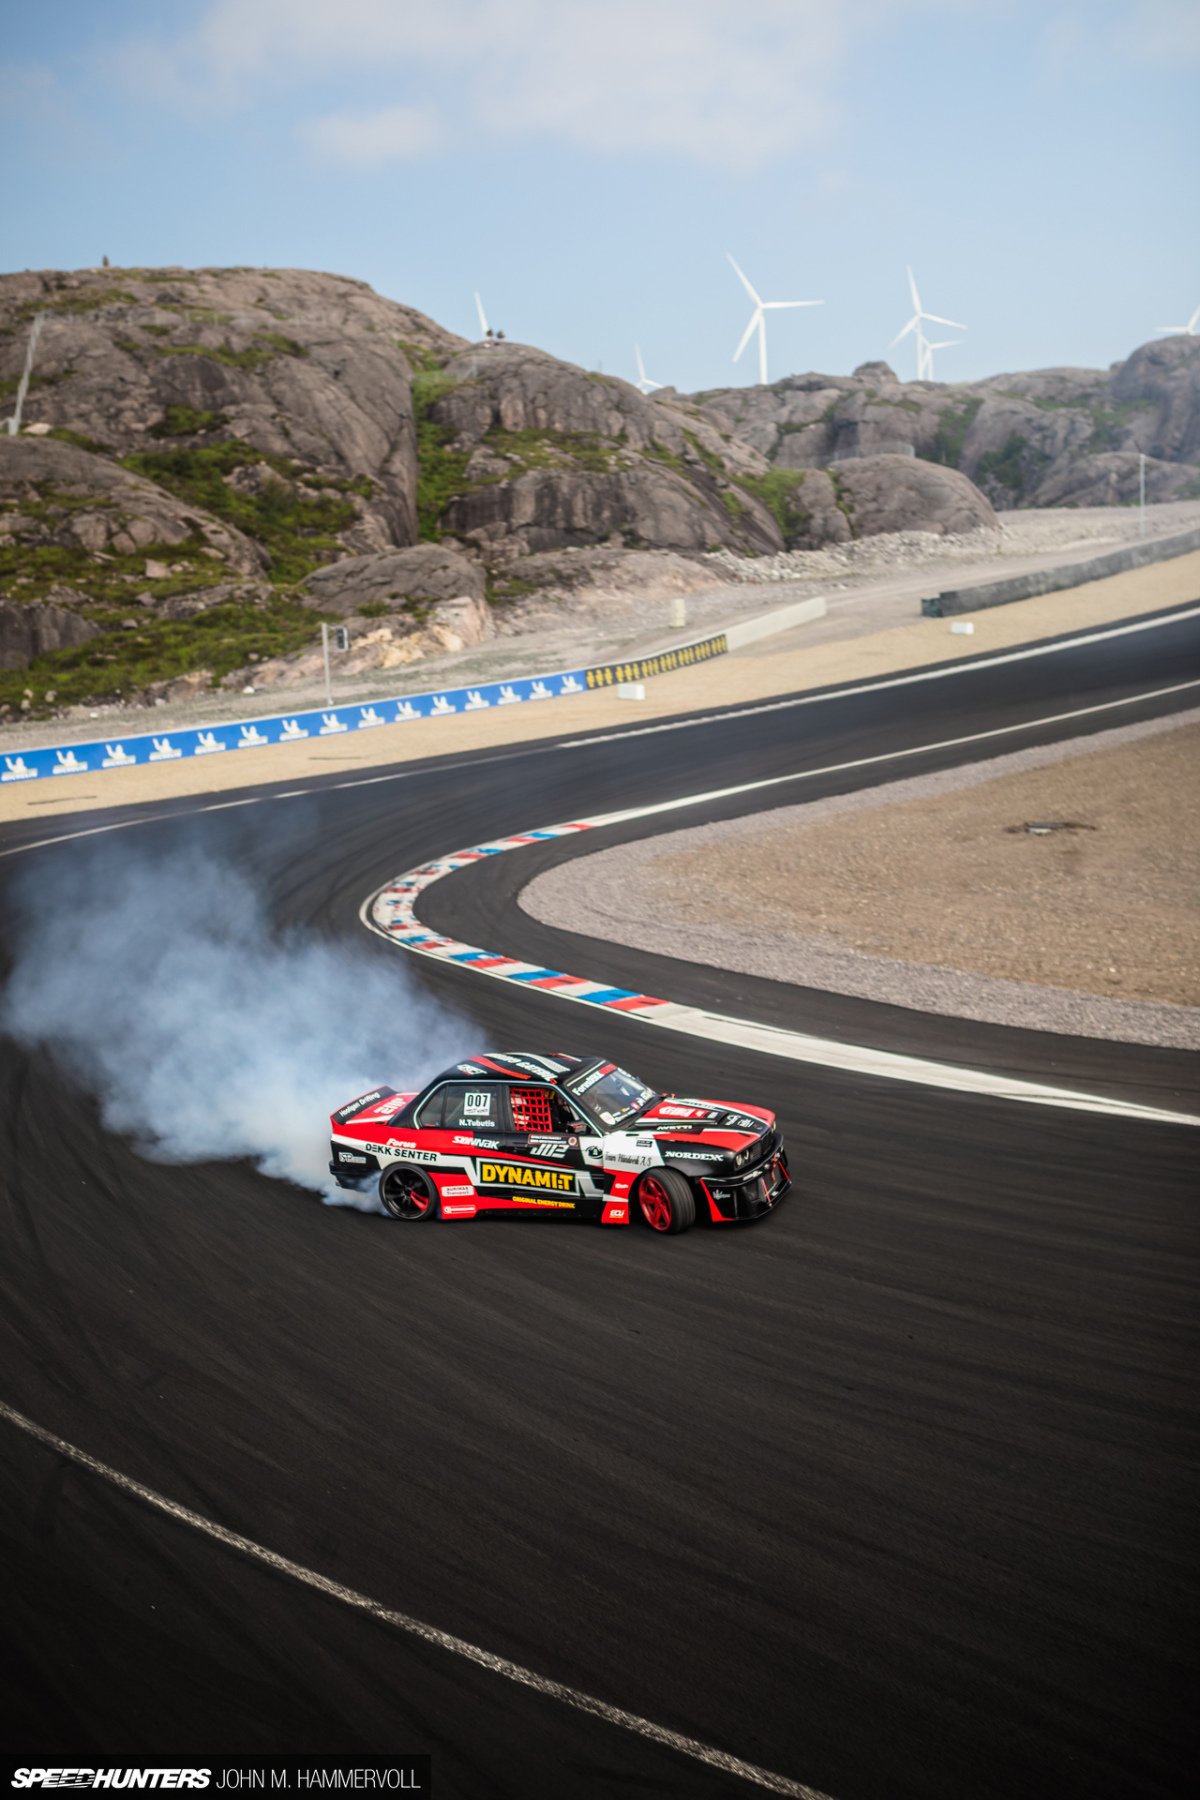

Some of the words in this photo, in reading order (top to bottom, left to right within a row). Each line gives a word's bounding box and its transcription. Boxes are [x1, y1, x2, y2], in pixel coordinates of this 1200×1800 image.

[467, 1094, 488, 1107] 007
[386, 1138, 417, 1149] Forus
[394, 1148, 438, 1162] SENTER
[537, 1198, 558, 1207] ENERGY
[558, 1201, 576, 1209] DRINK
